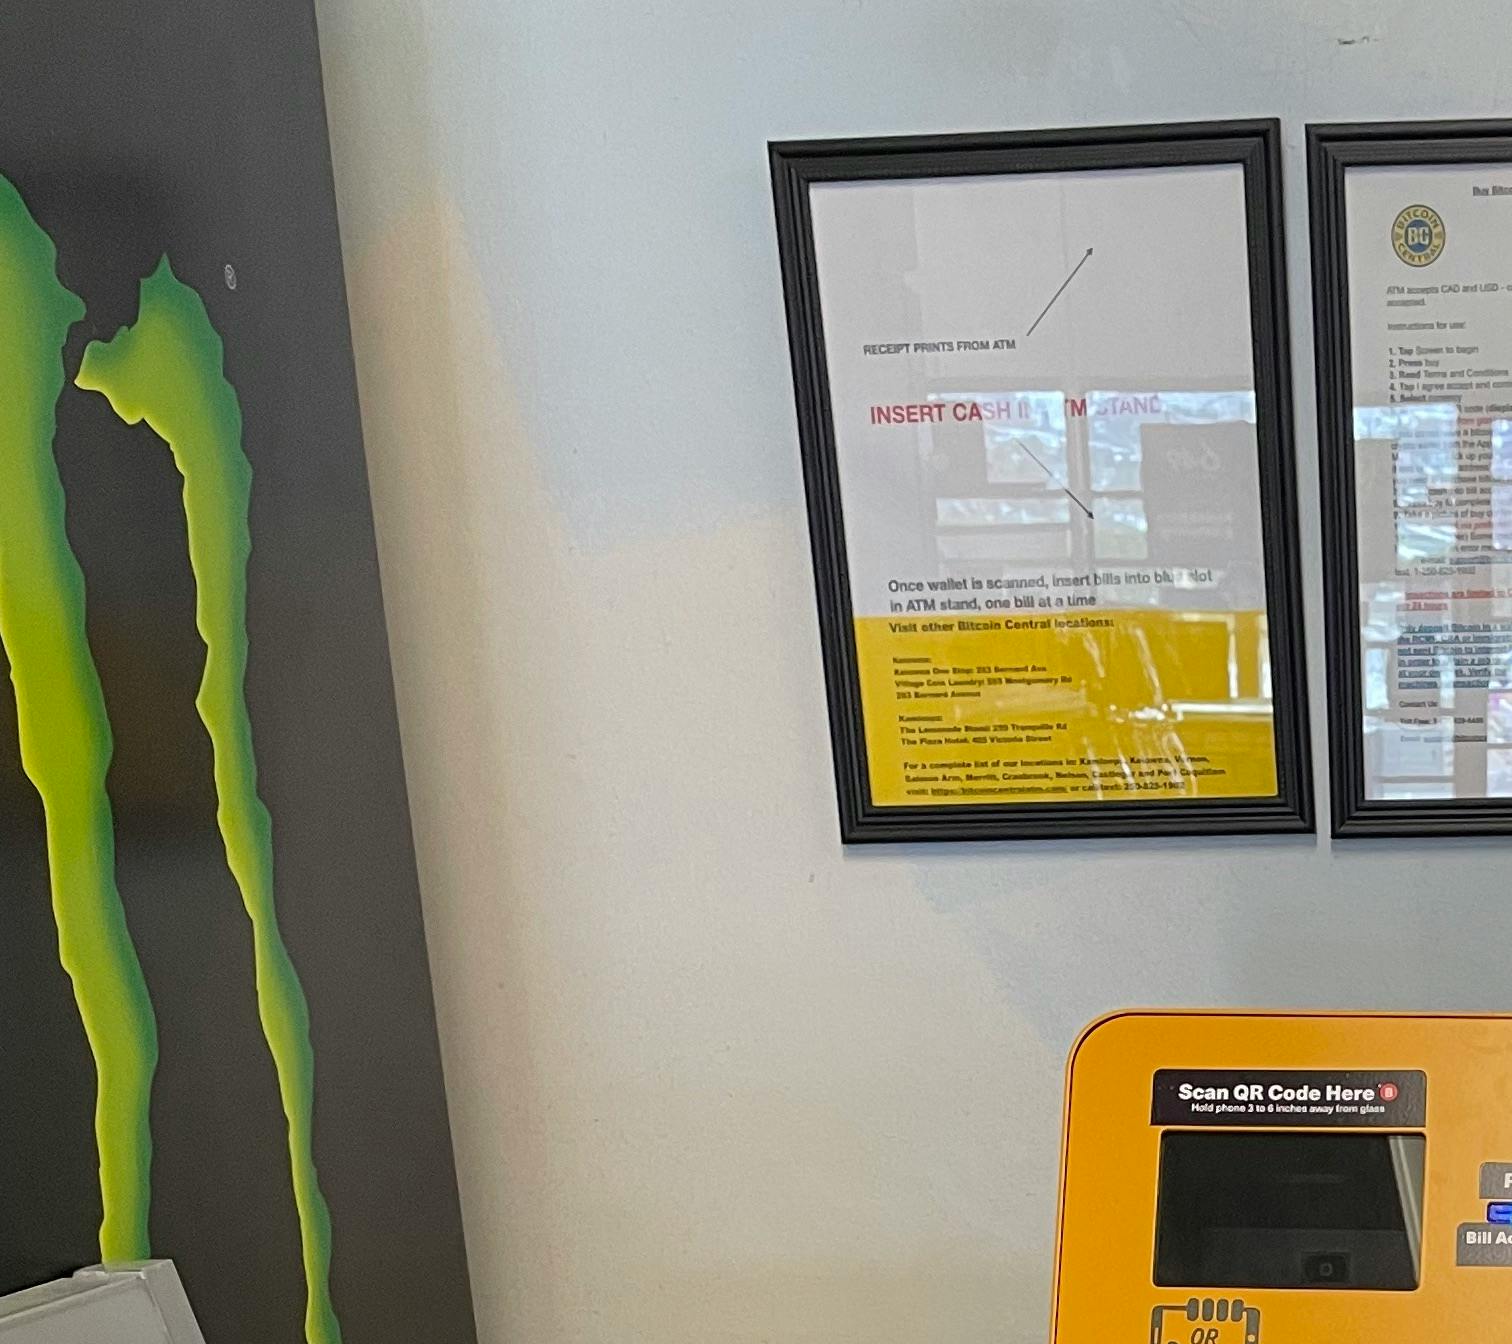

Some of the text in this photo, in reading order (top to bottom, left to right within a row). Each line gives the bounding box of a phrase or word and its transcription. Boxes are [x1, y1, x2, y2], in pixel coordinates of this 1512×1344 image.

[863, 339, 1016, 356] RECEIPT PRINTS FROM ATM
[870, 401, 1011, 424] INSERT CASH
[889, 571, 1150, 593] Once wallet is scanned, insert bills into
[890, 600, 902, 613] in
[906, 599, 936, 612] ATM
[940, 598, 982, 612] stand,
[985, 598, 1010, 610] one
[1014, 595, 1035, 609] bill
[1038, 596, 1051, 608] at
[1067, 594, 1096, 607] time
[889, 618, 1114, 633] Visit other Bitcoin Central locations:
[1178, 1083, 1375, 1101] Scan QR Code Here
[1191, 1103, 1213, 1113] Hold
[1216, 1104, 1245, 1114] phone
[1276, 1104, 1308, 1113] inches
[1309, 1106, 1333, 1114] away
[1335, 1104, 1358, 1113] from
[1360, 1105, 1385, 1114] glass
[1466, 1231, 1491, 1245] Bill
